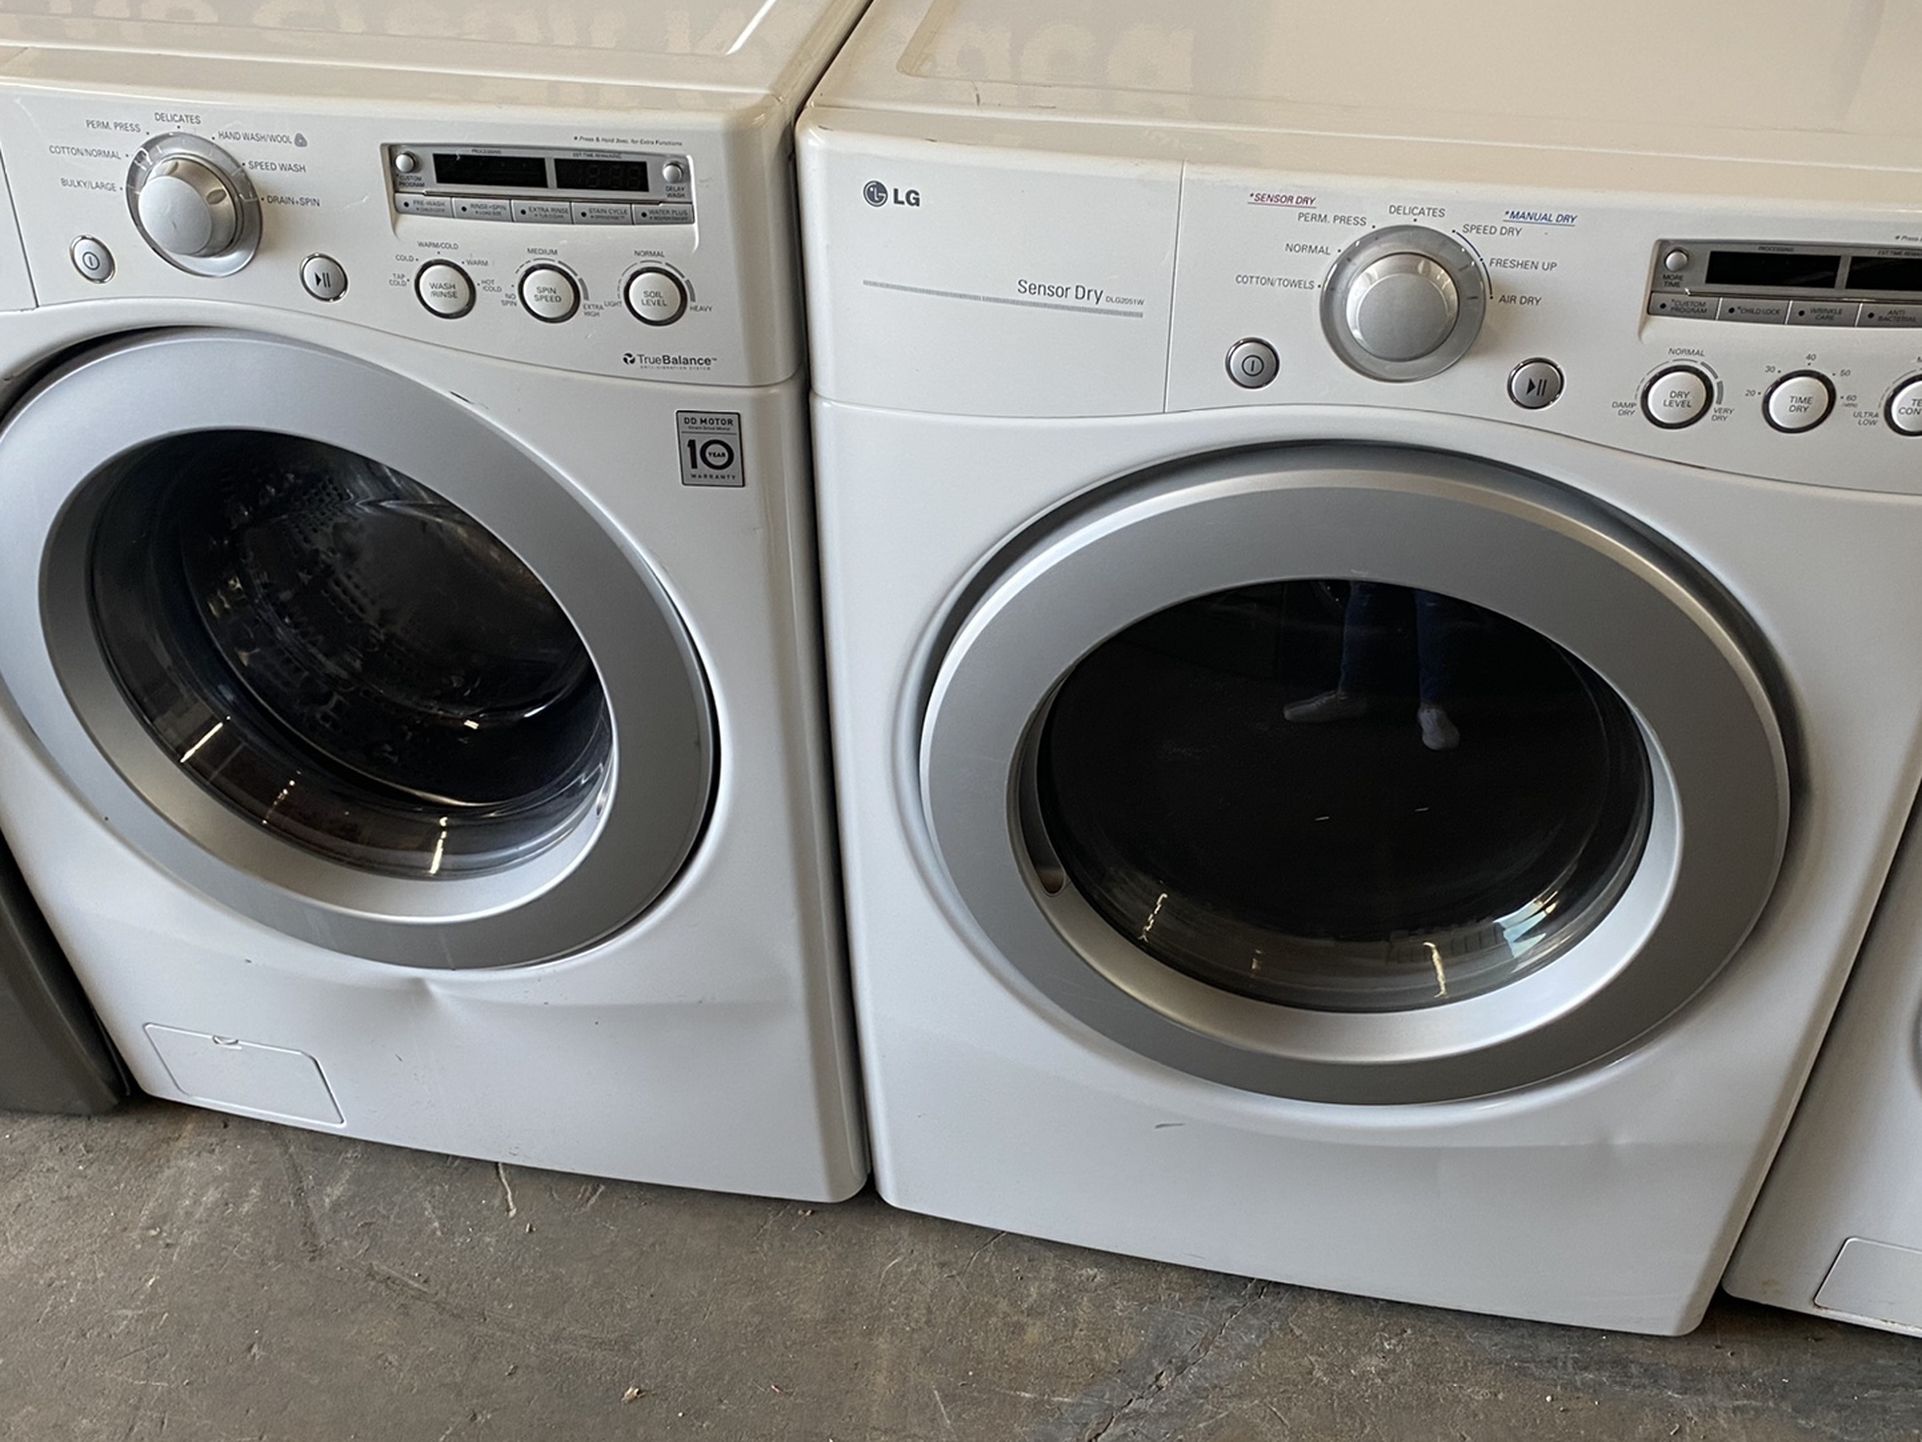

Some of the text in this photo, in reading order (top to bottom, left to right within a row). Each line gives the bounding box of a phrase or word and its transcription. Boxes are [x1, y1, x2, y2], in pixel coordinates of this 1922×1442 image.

[154, 112, 201, 125] DELICATES
[86, 120, 141, 133] PERM. PRESS
[218, 131, 292, 144] HAND WASH/WOOL
[248, 161, 306, 173] SPEED WASH
[61, 178, 117, 192] BULKY/LARGE
[893, 188, 920, 207] LG
[1295, 195, 1316, 206] DRY
[1389, 204, 1446, 218] DELICATES
[1297, 212, 1367, 227] PERM. PRESS
[1555, 214, 1577, 224] DRY
[1462, 224, 1522, 237] SPEED DRY
[417, 241, 459, 250] WARM/COLD
[1285, 243, 1332, 255] NORMAL
[527, 248, 558, 256] MEDIUM
[634, 250, 665, 258] NORMAL
[467, 259, 488, 267] WARM
[1489, 258, 1558, 271] FRESHEN UP
[389, 279, 407, 287] COLD
[429, 282, 457, 291] WASH
[1235, 274, 1315, 290] COTTON/TOWELS
[643, 290, 663, 299] SOIL
[1017, 279, 1071, 298] Sensor
[1075, 284, 1104, 305] Dry
[534, 294, 562, 303] SPEED
[641, 299, 667, 307] LEVEL
[1498, 295, 1542, 306] AIR DRY
[1668, 348, 1706, 356] NORMAL
[1669, 390, 1690, 399] DRY
[1745, 389, 1756, 397] 20
[1663, 400, 1692, 408] LEVEL
[1790, 396, 1814, 405] TIME
[1789, 405, 1810, 413] DRY
[684, 417, 734, 426] DD MOTOR
[1858, 418, 1878, 426] LOW
[687, 439, 734, 471] 10
